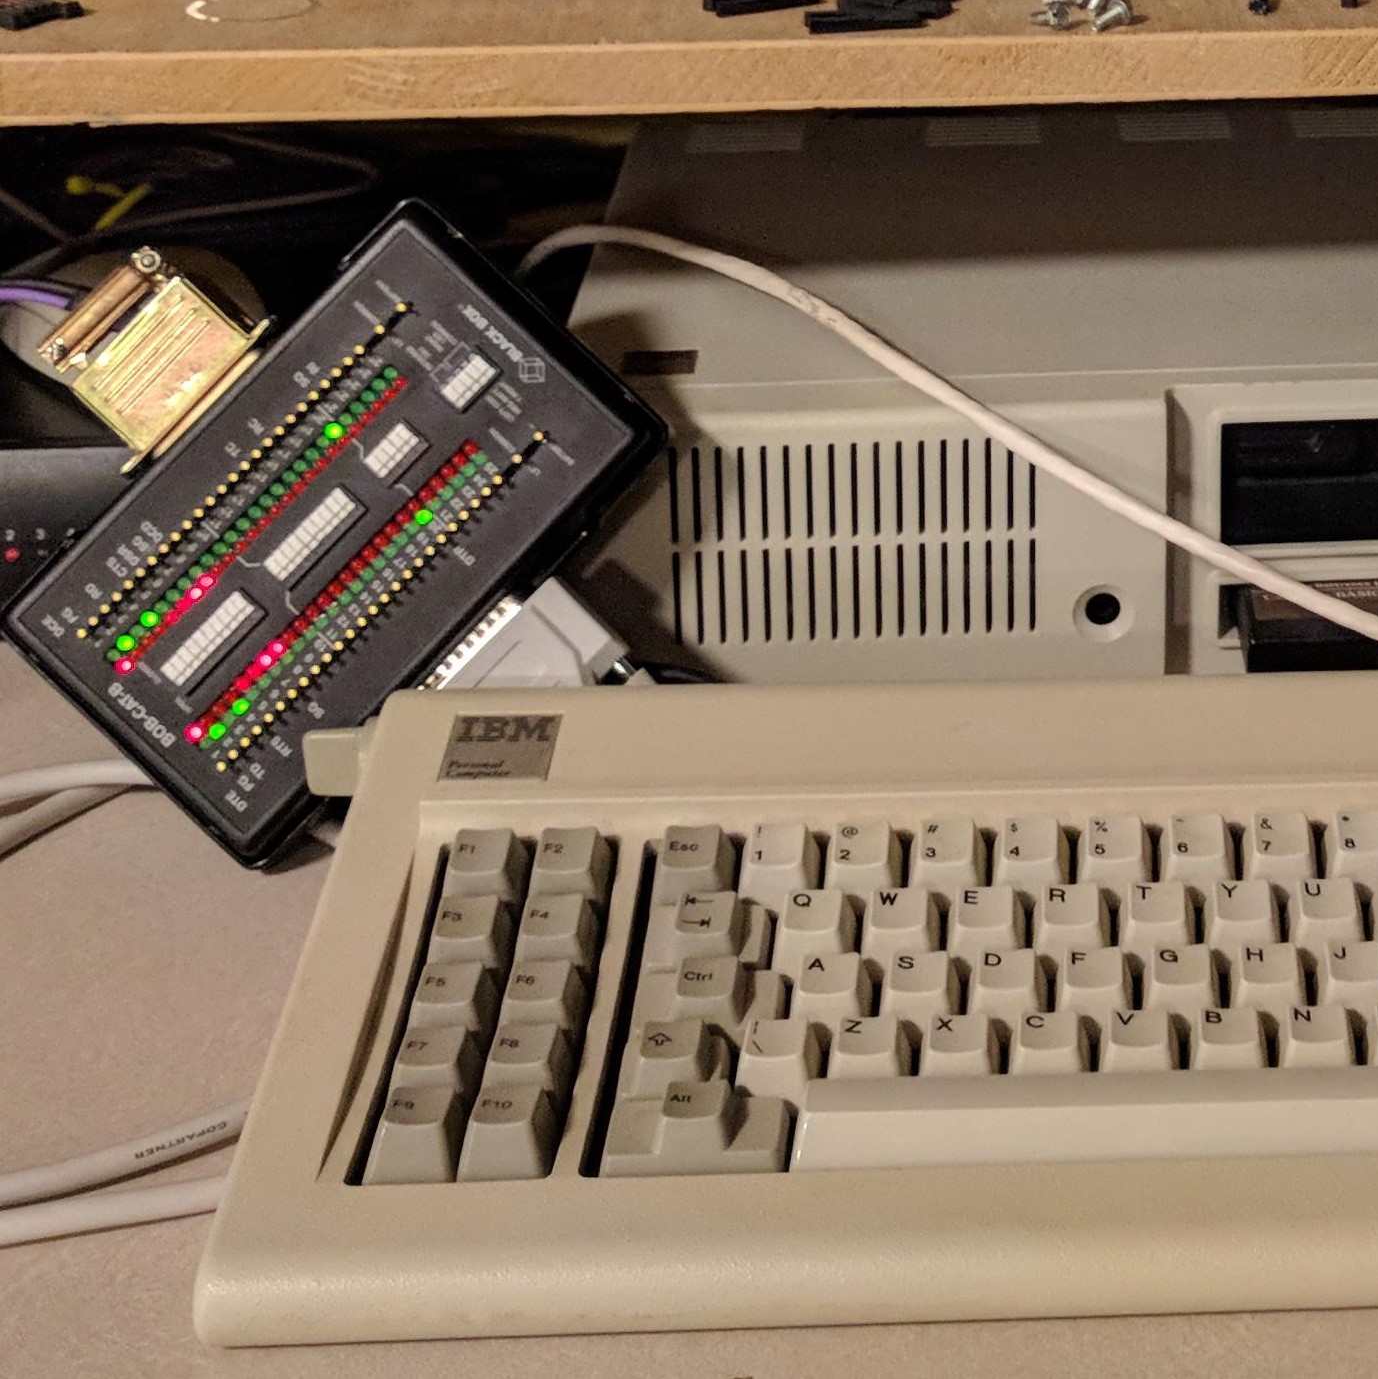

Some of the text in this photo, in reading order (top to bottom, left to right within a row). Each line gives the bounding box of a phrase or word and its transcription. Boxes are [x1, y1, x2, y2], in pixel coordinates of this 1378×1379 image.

[485, 326, 523, 362] BLACK
[108, 682, 176, 747] BOB-CAT-B
[457, 716, 559, 742] IBM
[447, 760, 504, 769] Personal
[445, 770, 511, 780] Computer
[458, 842, 476, 855] F1
[543, 842, 564, 854] F2
[668, 840, 699, 853] Esc
[1094, 844, 1106, 855] 5
[1177, 842, 1189, 853] 6
[1261, 840, 1272, 851] 7
[1344, 837, 1356, 849] 8
[754, 849, 763, 860] 1
[839, 849, 850, 860] 2
[925, 846, 936, 858] 3
[1008, 845, 1020, 857] 4
[1050, 888, 1066, 903] R
[1136, 885, 1152, 900] T
[1221, 884, 1238, 899] Y
[1304, 881, 1321, 897] U
[793, 893, 812, 909] Q
[879, 891, 898, 906] W
[963, 890, 978, 904] E
[441, 910, 463, 922] F3
[529, 909, 550, 920] F4
[984, 952, 1002, 967] D
[1071, 951, 1087, 966] F
[1159, 948, 1178, 963] G
[1245, 947, 1264, 962] H
[1334, 946, 1346, 960] J
[808, 957, 825, 972] A
[897, 955, 915, 970] S
[425, 975, 446, 988] F5
[515, 973, 536, 986] F6
[684, 970, 713, 983] Ctrl
[1025, 1014, 1044, 1029] C
[1116, 1011, 1134, 1026] V
[1205, 1010, 1223, 1024] B
[1293, 1008, 1311, 1022] N
[844, 1019, 862, 1034] Z
[936, 1018, 954, 1032] X
[406, 1039, 428, 1052] F7
[499, 1037, 520, 1050] F8
[481, 1098, 513, 1111] F10
[669, 1092, 692, 1105] Alt
[133, 1121, 228, 1161] COPARTNER
